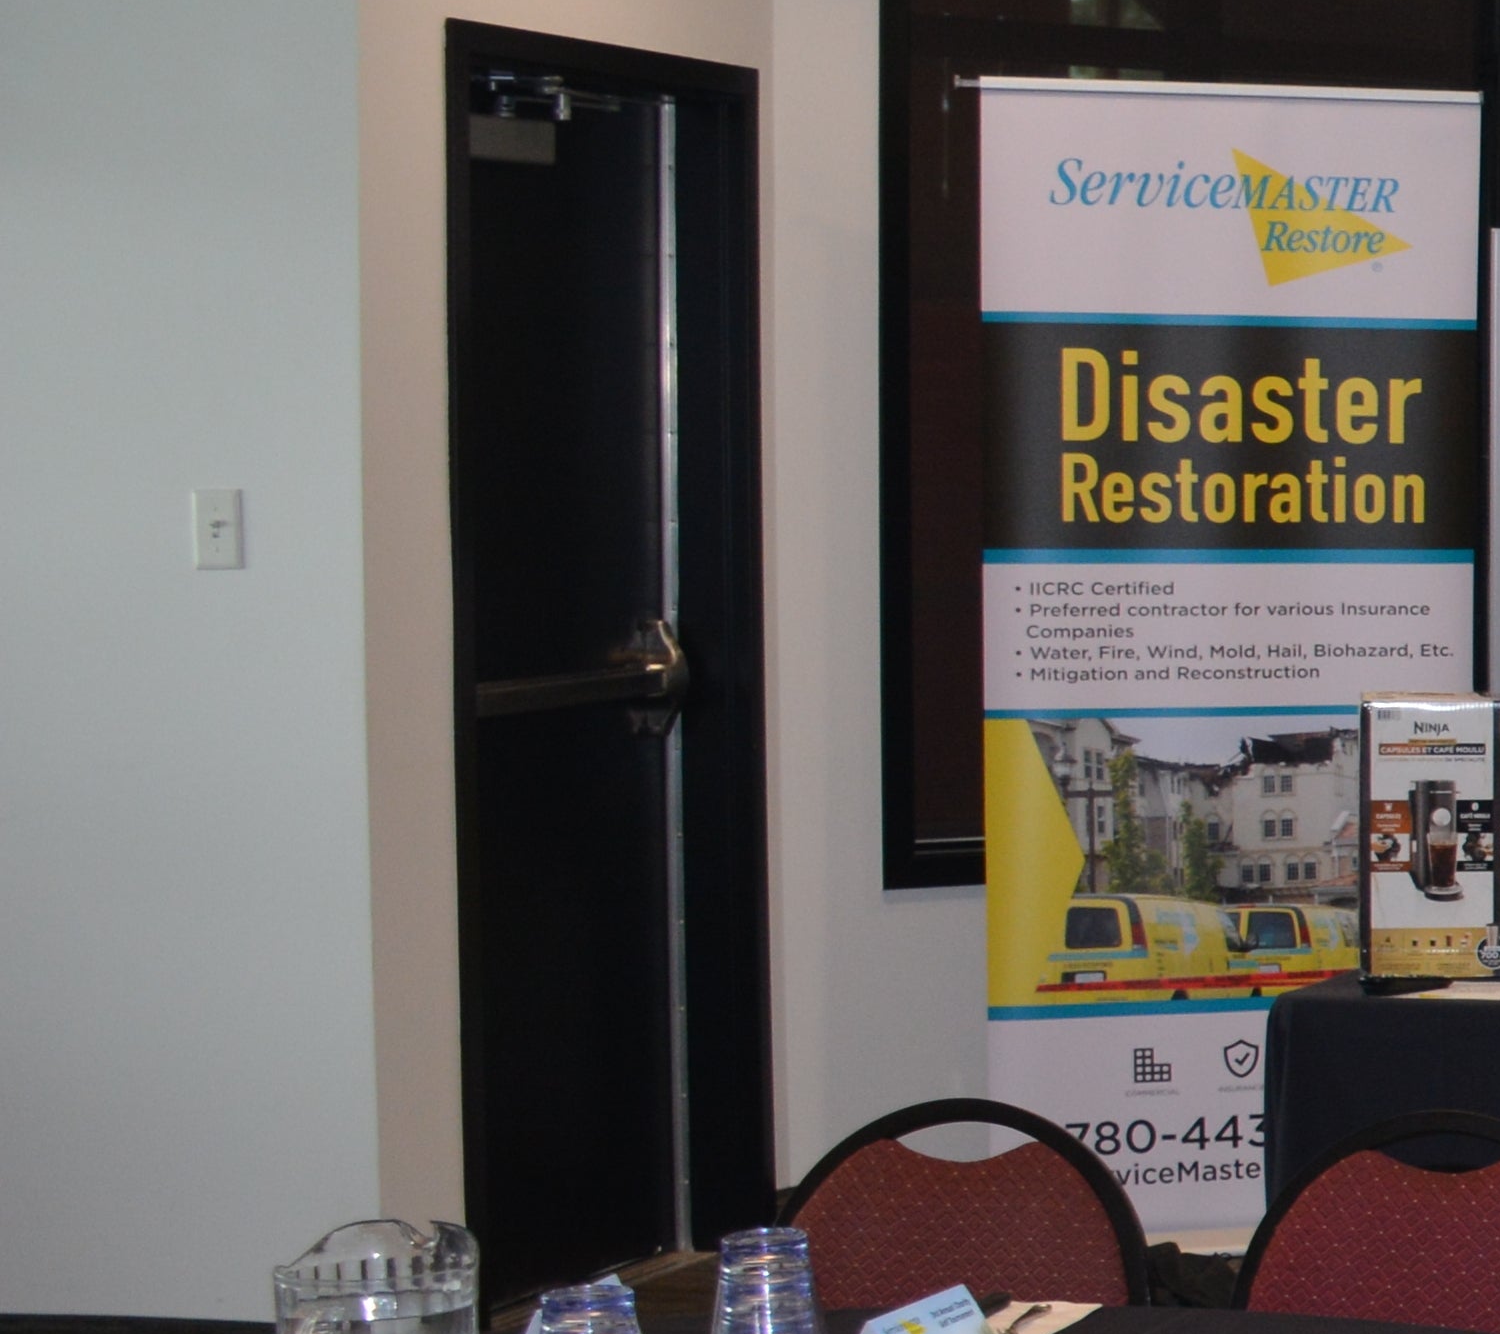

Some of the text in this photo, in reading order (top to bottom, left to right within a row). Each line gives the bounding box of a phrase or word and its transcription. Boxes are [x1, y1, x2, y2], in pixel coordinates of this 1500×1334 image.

[1049, 158, 1399, 213] ServiceMASTER
[1261, 222, 1385, 254] Restore
[1061, 347, 1422, 444] Disaster
[1061, 452, 1424, 524] Restoration
[1030, 581, 1174, 596] IICRC Certified
[1030, 602, 1430, 618] Preferred contractor for various Insurance
[1027, 624, 1134, 642] Companies
[1031, 643, 1453, 662] Water, Fire, Wind, Mold, Hail, Biohazard, Etc.
[1031, 665, 1320, 683] Mitigation and Reconstruction
[1414, 721, 1449, 736] NINJA
